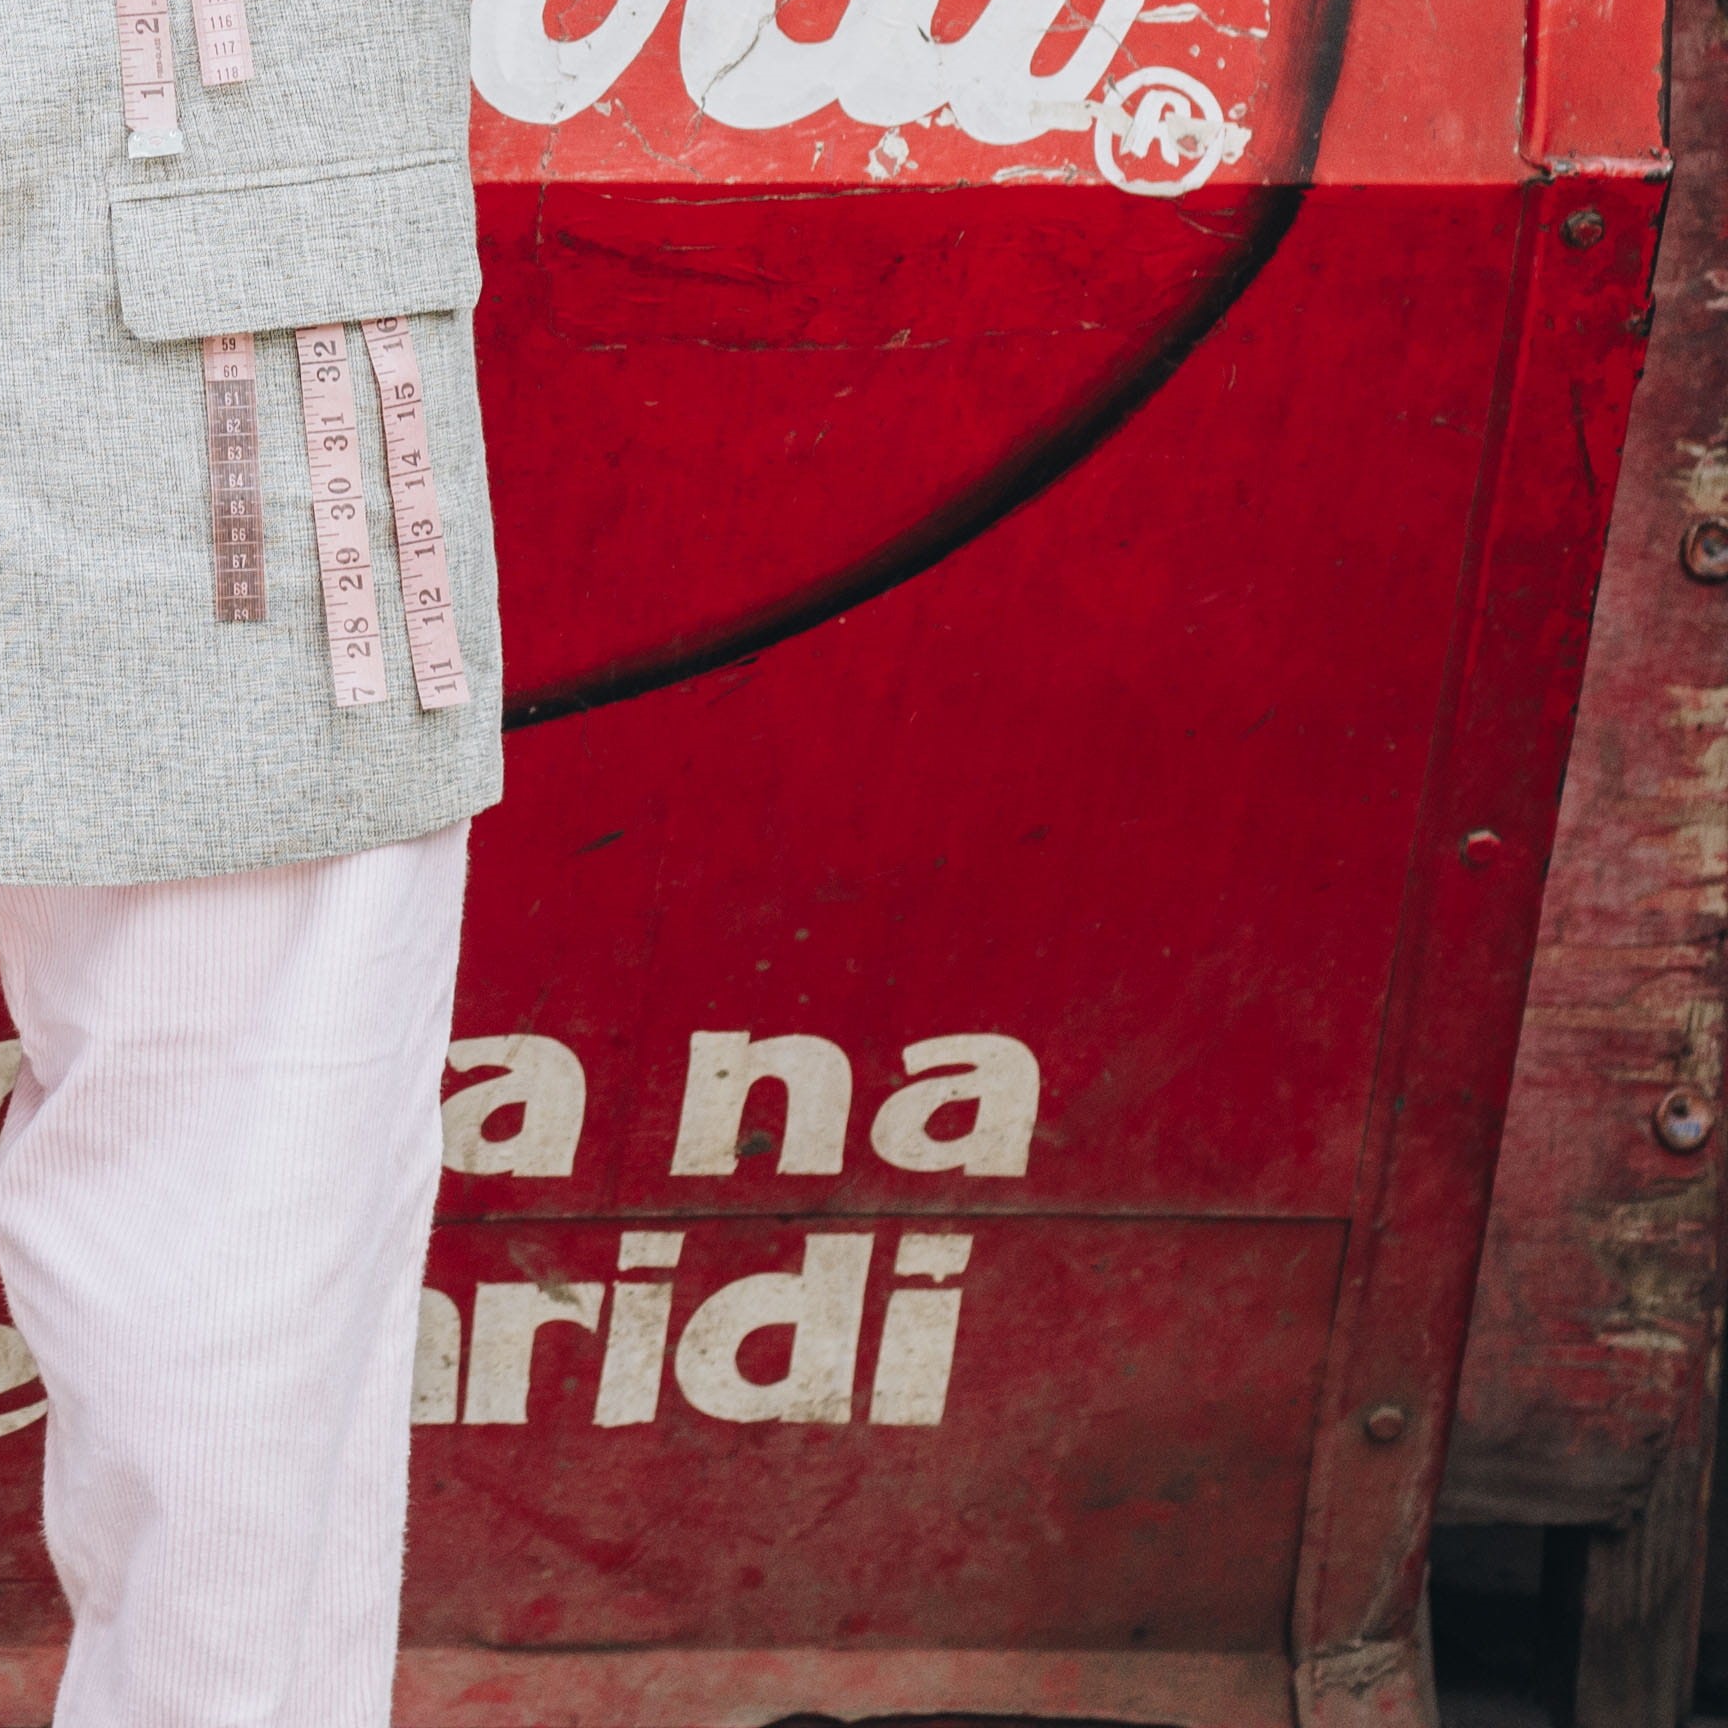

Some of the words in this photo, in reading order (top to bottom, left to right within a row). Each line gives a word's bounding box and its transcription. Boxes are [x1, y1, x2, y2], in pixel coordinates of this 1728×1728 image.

[136, 17, 160, 35] 2
[210, 15, 232, 29] 116
[213, 42, 236, 56] 117
[216, 67, 239, 81] 118
[141, 86, 164, 98] 1
[221, 338, 236, 351] 59
[223, 365, 238, 379] 60
[225, 392, 240, 406] 61
[226, 419, 241, 433] 62
[227, 446, 243, 460] 63
[229, 474, 244, 488] 64
[230, 501, 245, 515] 65
[231, 528, 246, 542] 66
[232, 555, 247, 569] 67
[233, 582, 248, 596] 68
[669, 1030, 1042, 1178] na
